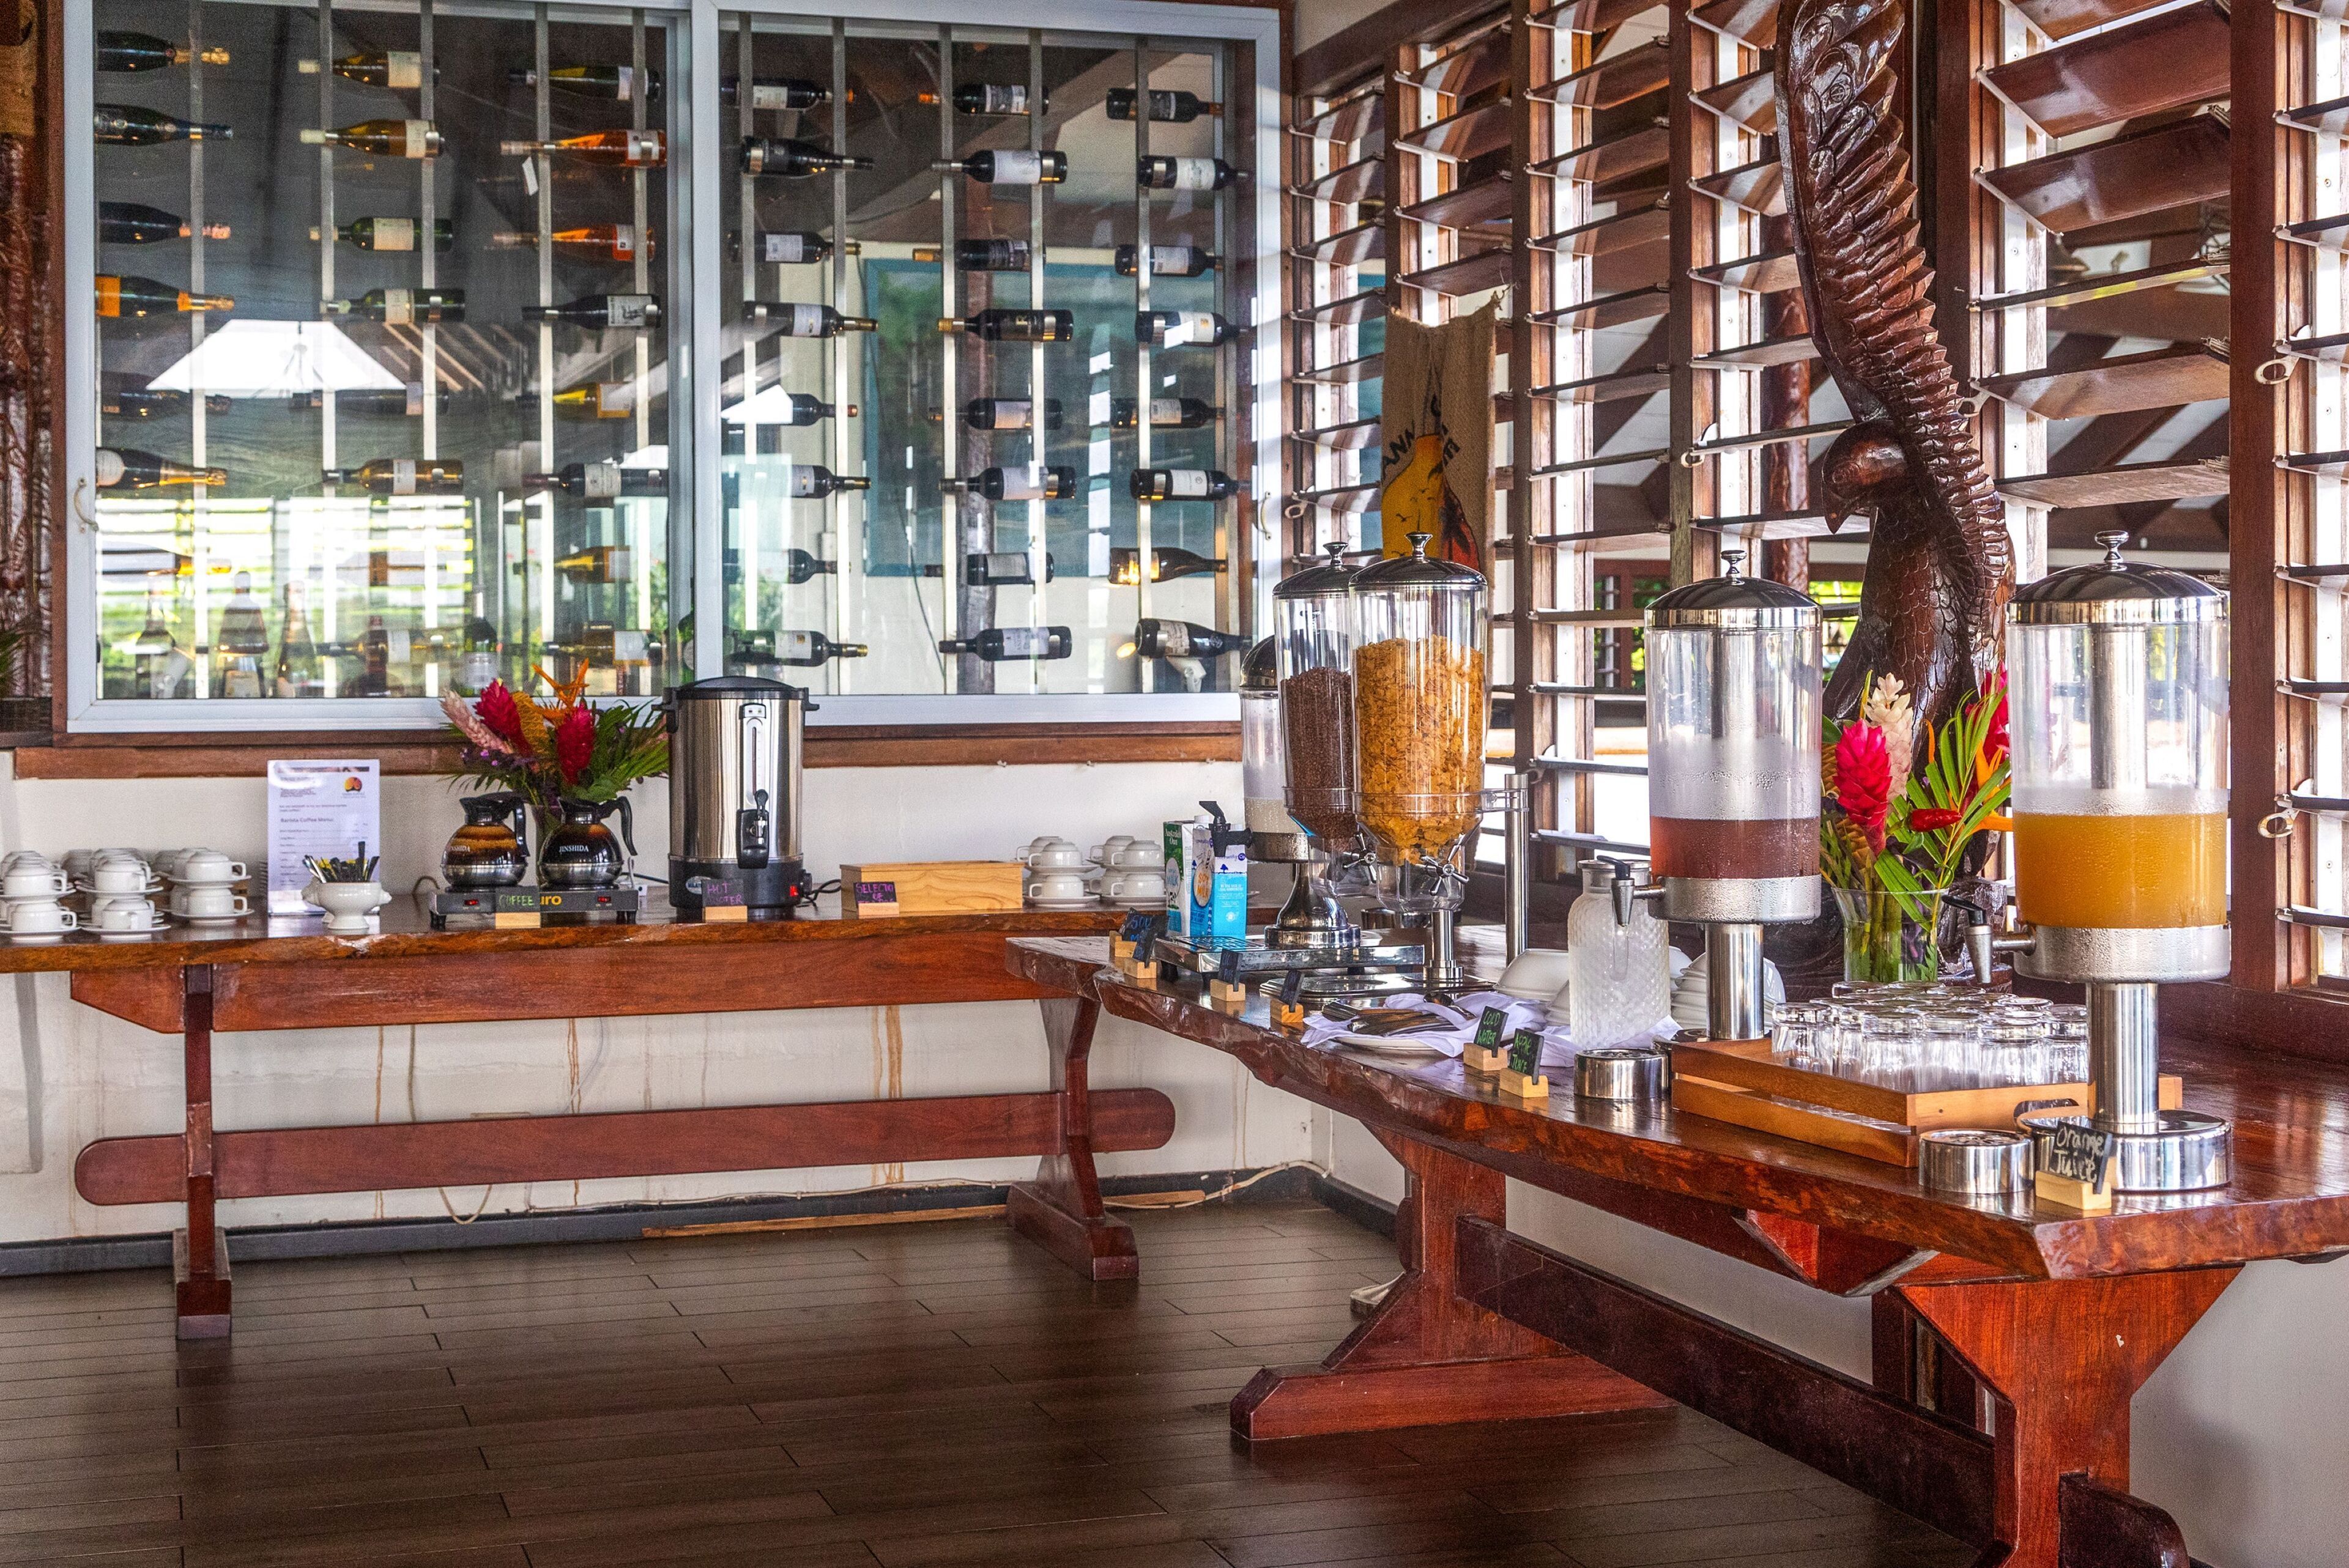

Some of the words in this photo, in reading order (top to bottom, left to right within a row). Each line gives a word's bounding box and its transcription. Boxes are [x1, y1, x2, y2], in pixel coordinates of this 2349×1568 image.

[499, 894, 534, 906] COFFEE
[540, 895, 562, 905] uro
[1483, 1010, 1501, 1026] COLD
[1477, 1029, 1497, 1045] WATER
[2056, 1125, 2104, 1162] Orange
[2049, 1149, 2098, 1184] Juice
